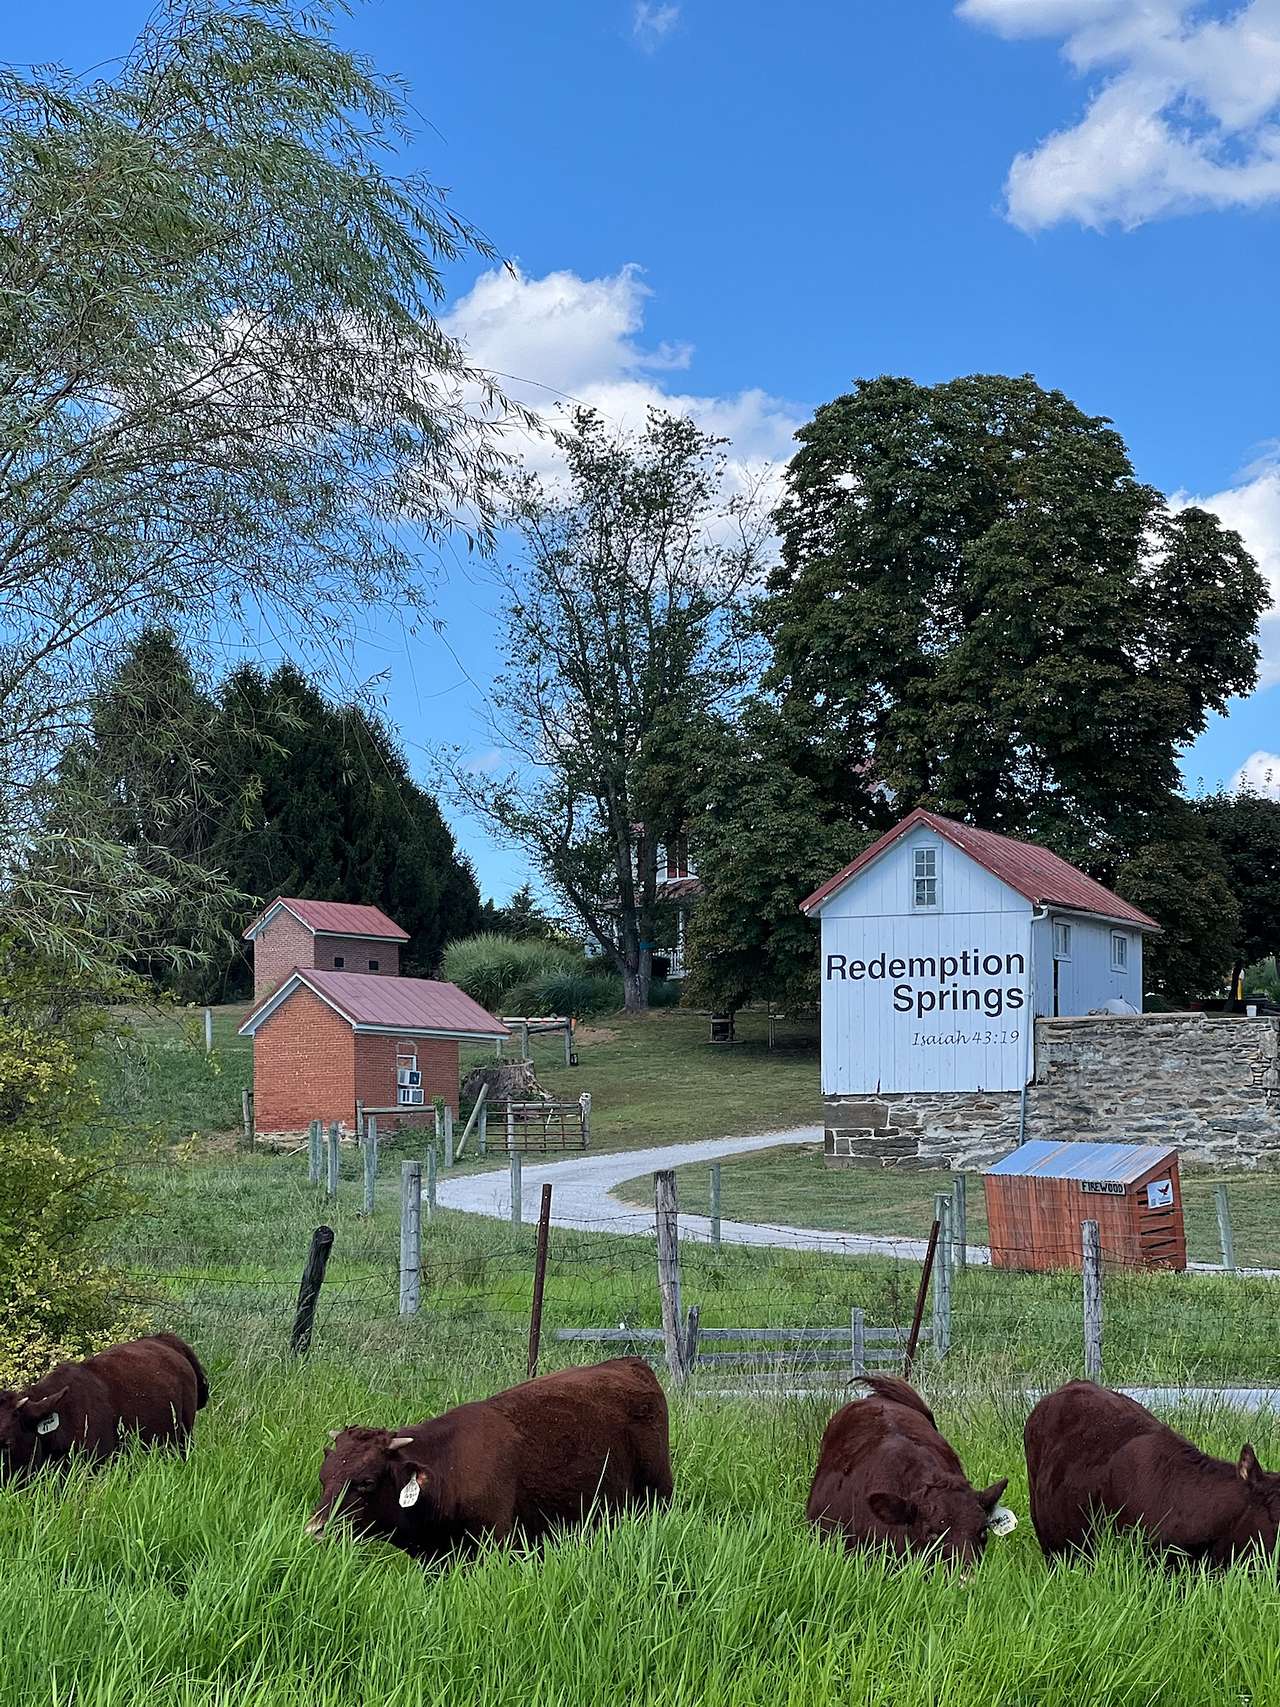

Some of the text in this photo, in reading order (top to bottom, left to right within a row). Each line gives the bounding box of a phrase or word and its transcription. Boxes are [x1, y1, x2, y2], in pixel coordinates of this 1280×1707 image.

[827, 949, 1025, 984] Redemption
[893, 983, 1025, 1018] Springs
[912, 1030, 1019, 1046] Isaiah 43:19
[1082, 1181, 1124, 1194] FIREWOOD
